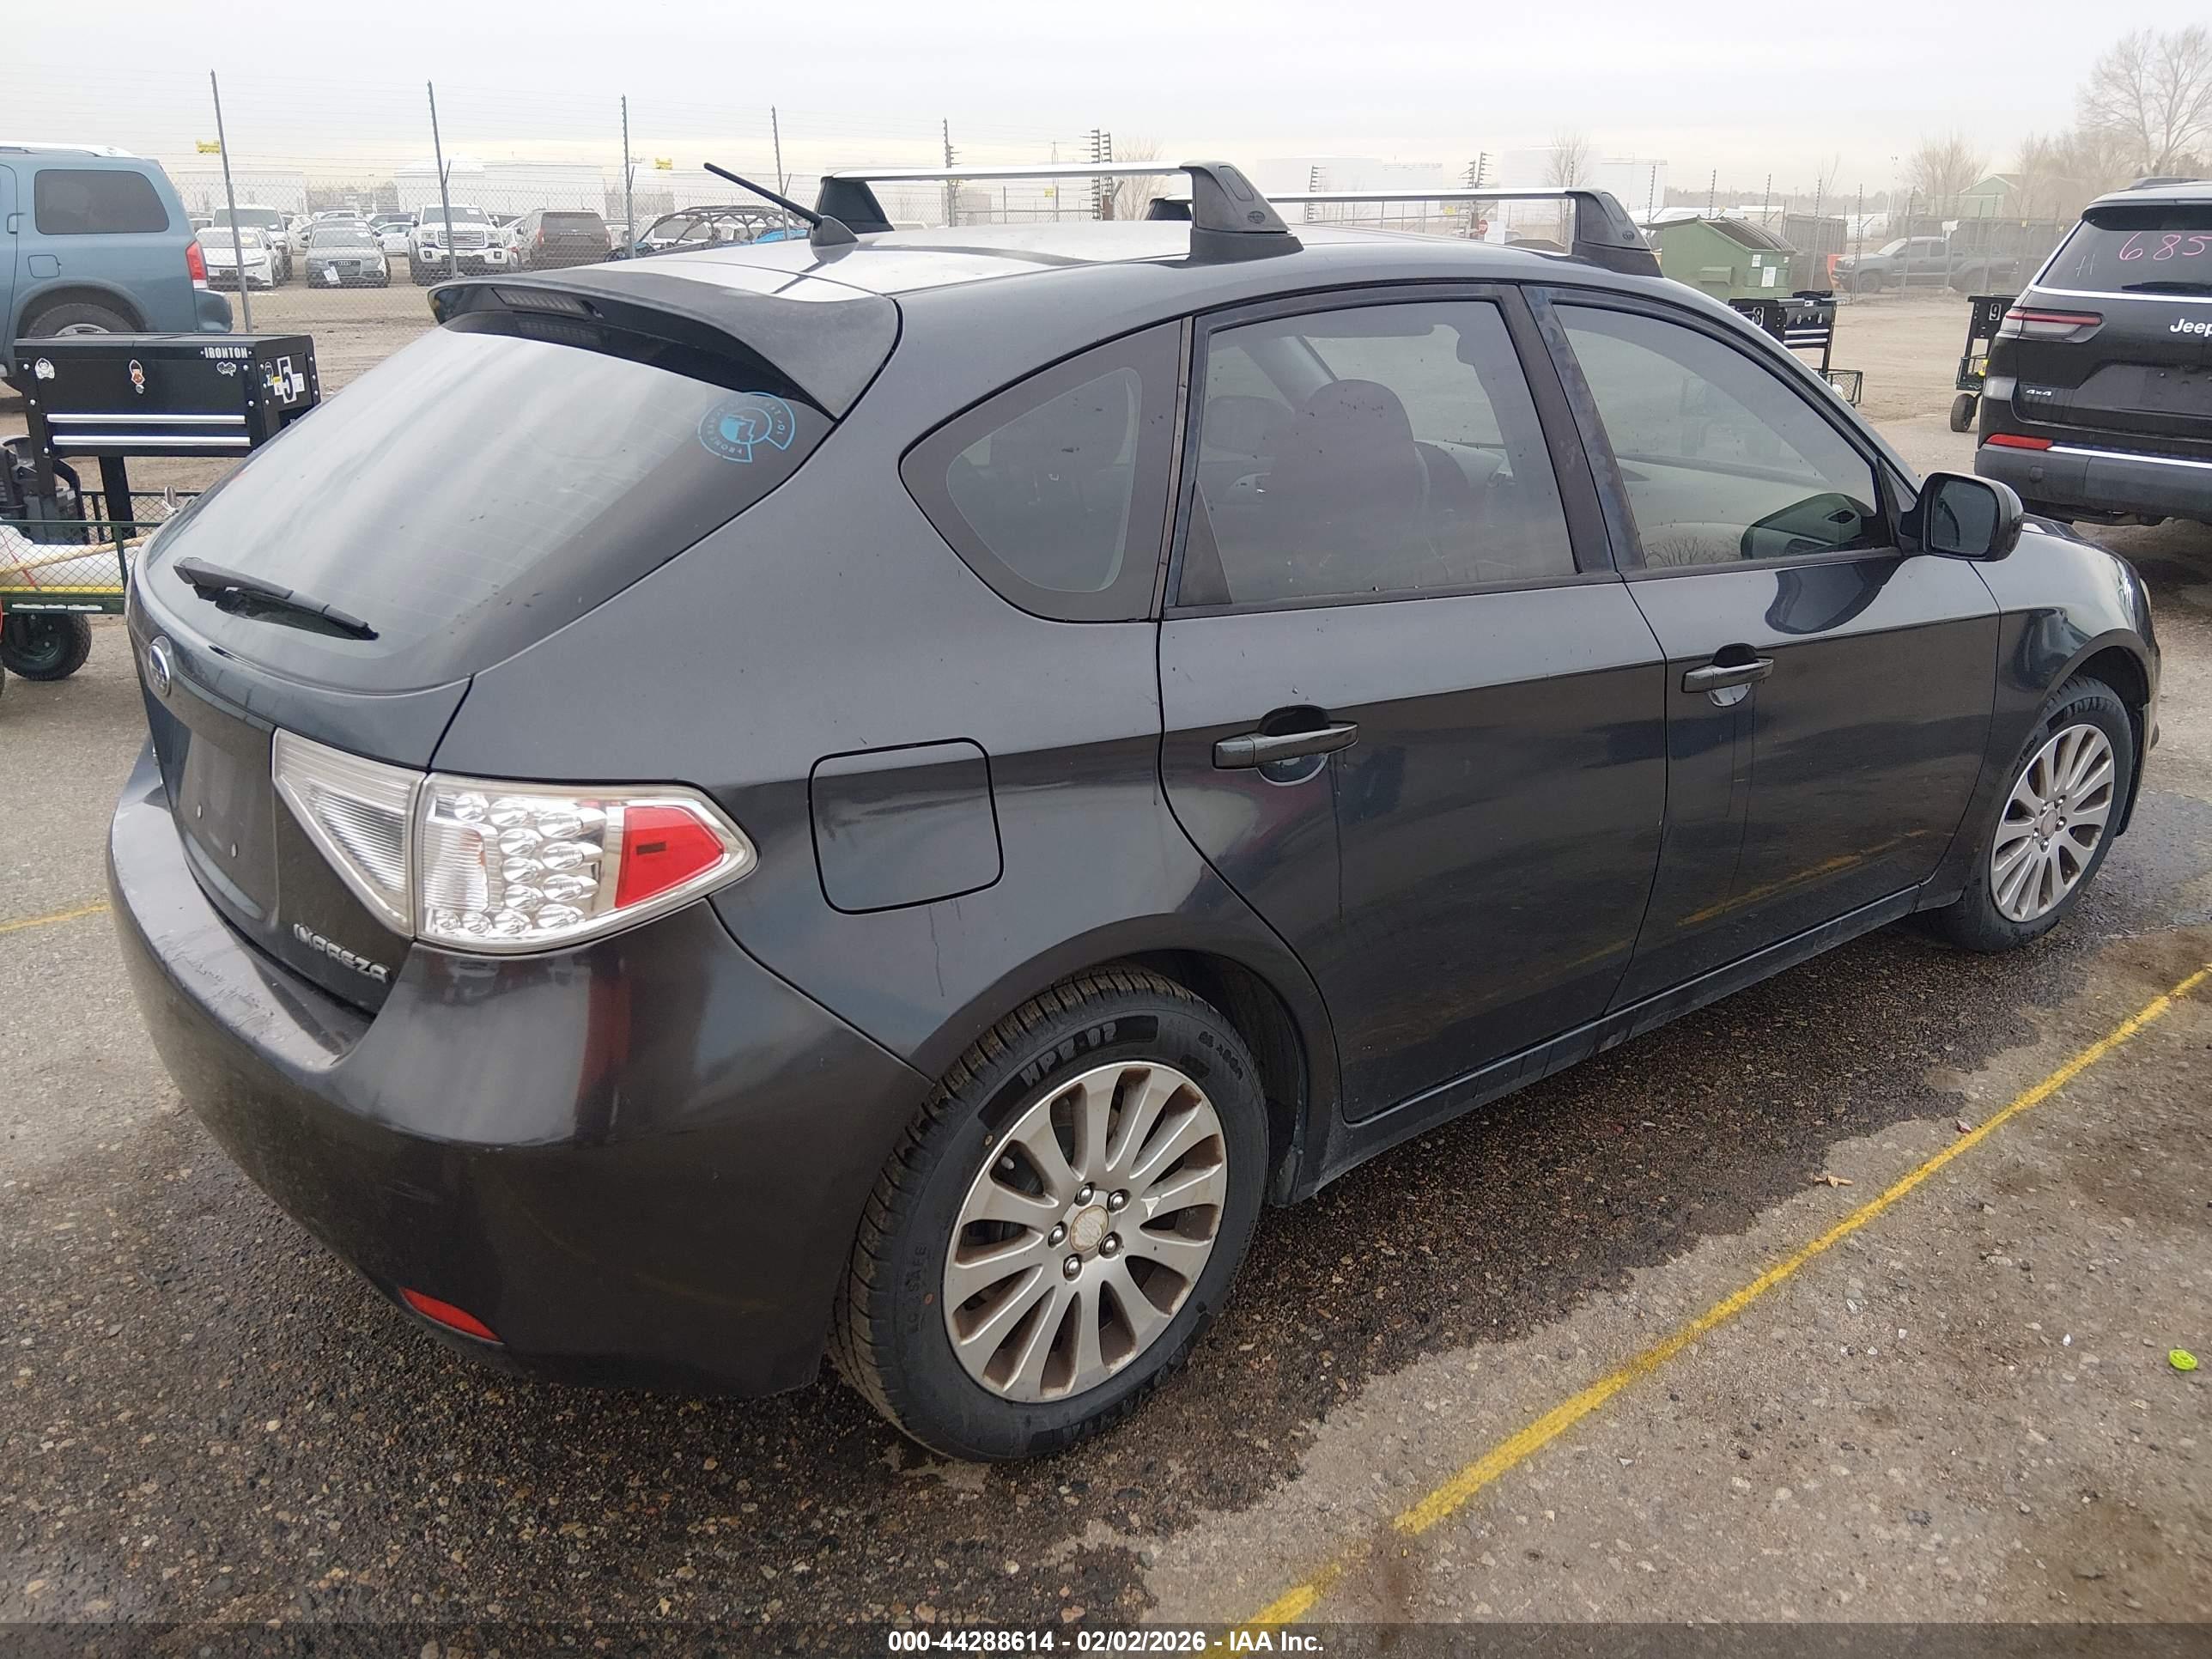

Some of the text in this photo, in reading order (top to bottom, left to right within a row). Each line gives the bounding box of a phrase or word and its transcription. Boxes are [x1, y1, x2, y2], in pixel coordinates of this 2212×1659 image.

[1990, 304, 2000, 320] 9
[204, 347, 248, 359] IRONTON
[280, 359, 294, 400] 5
[293, 923, 391, 982] IMPREZA
